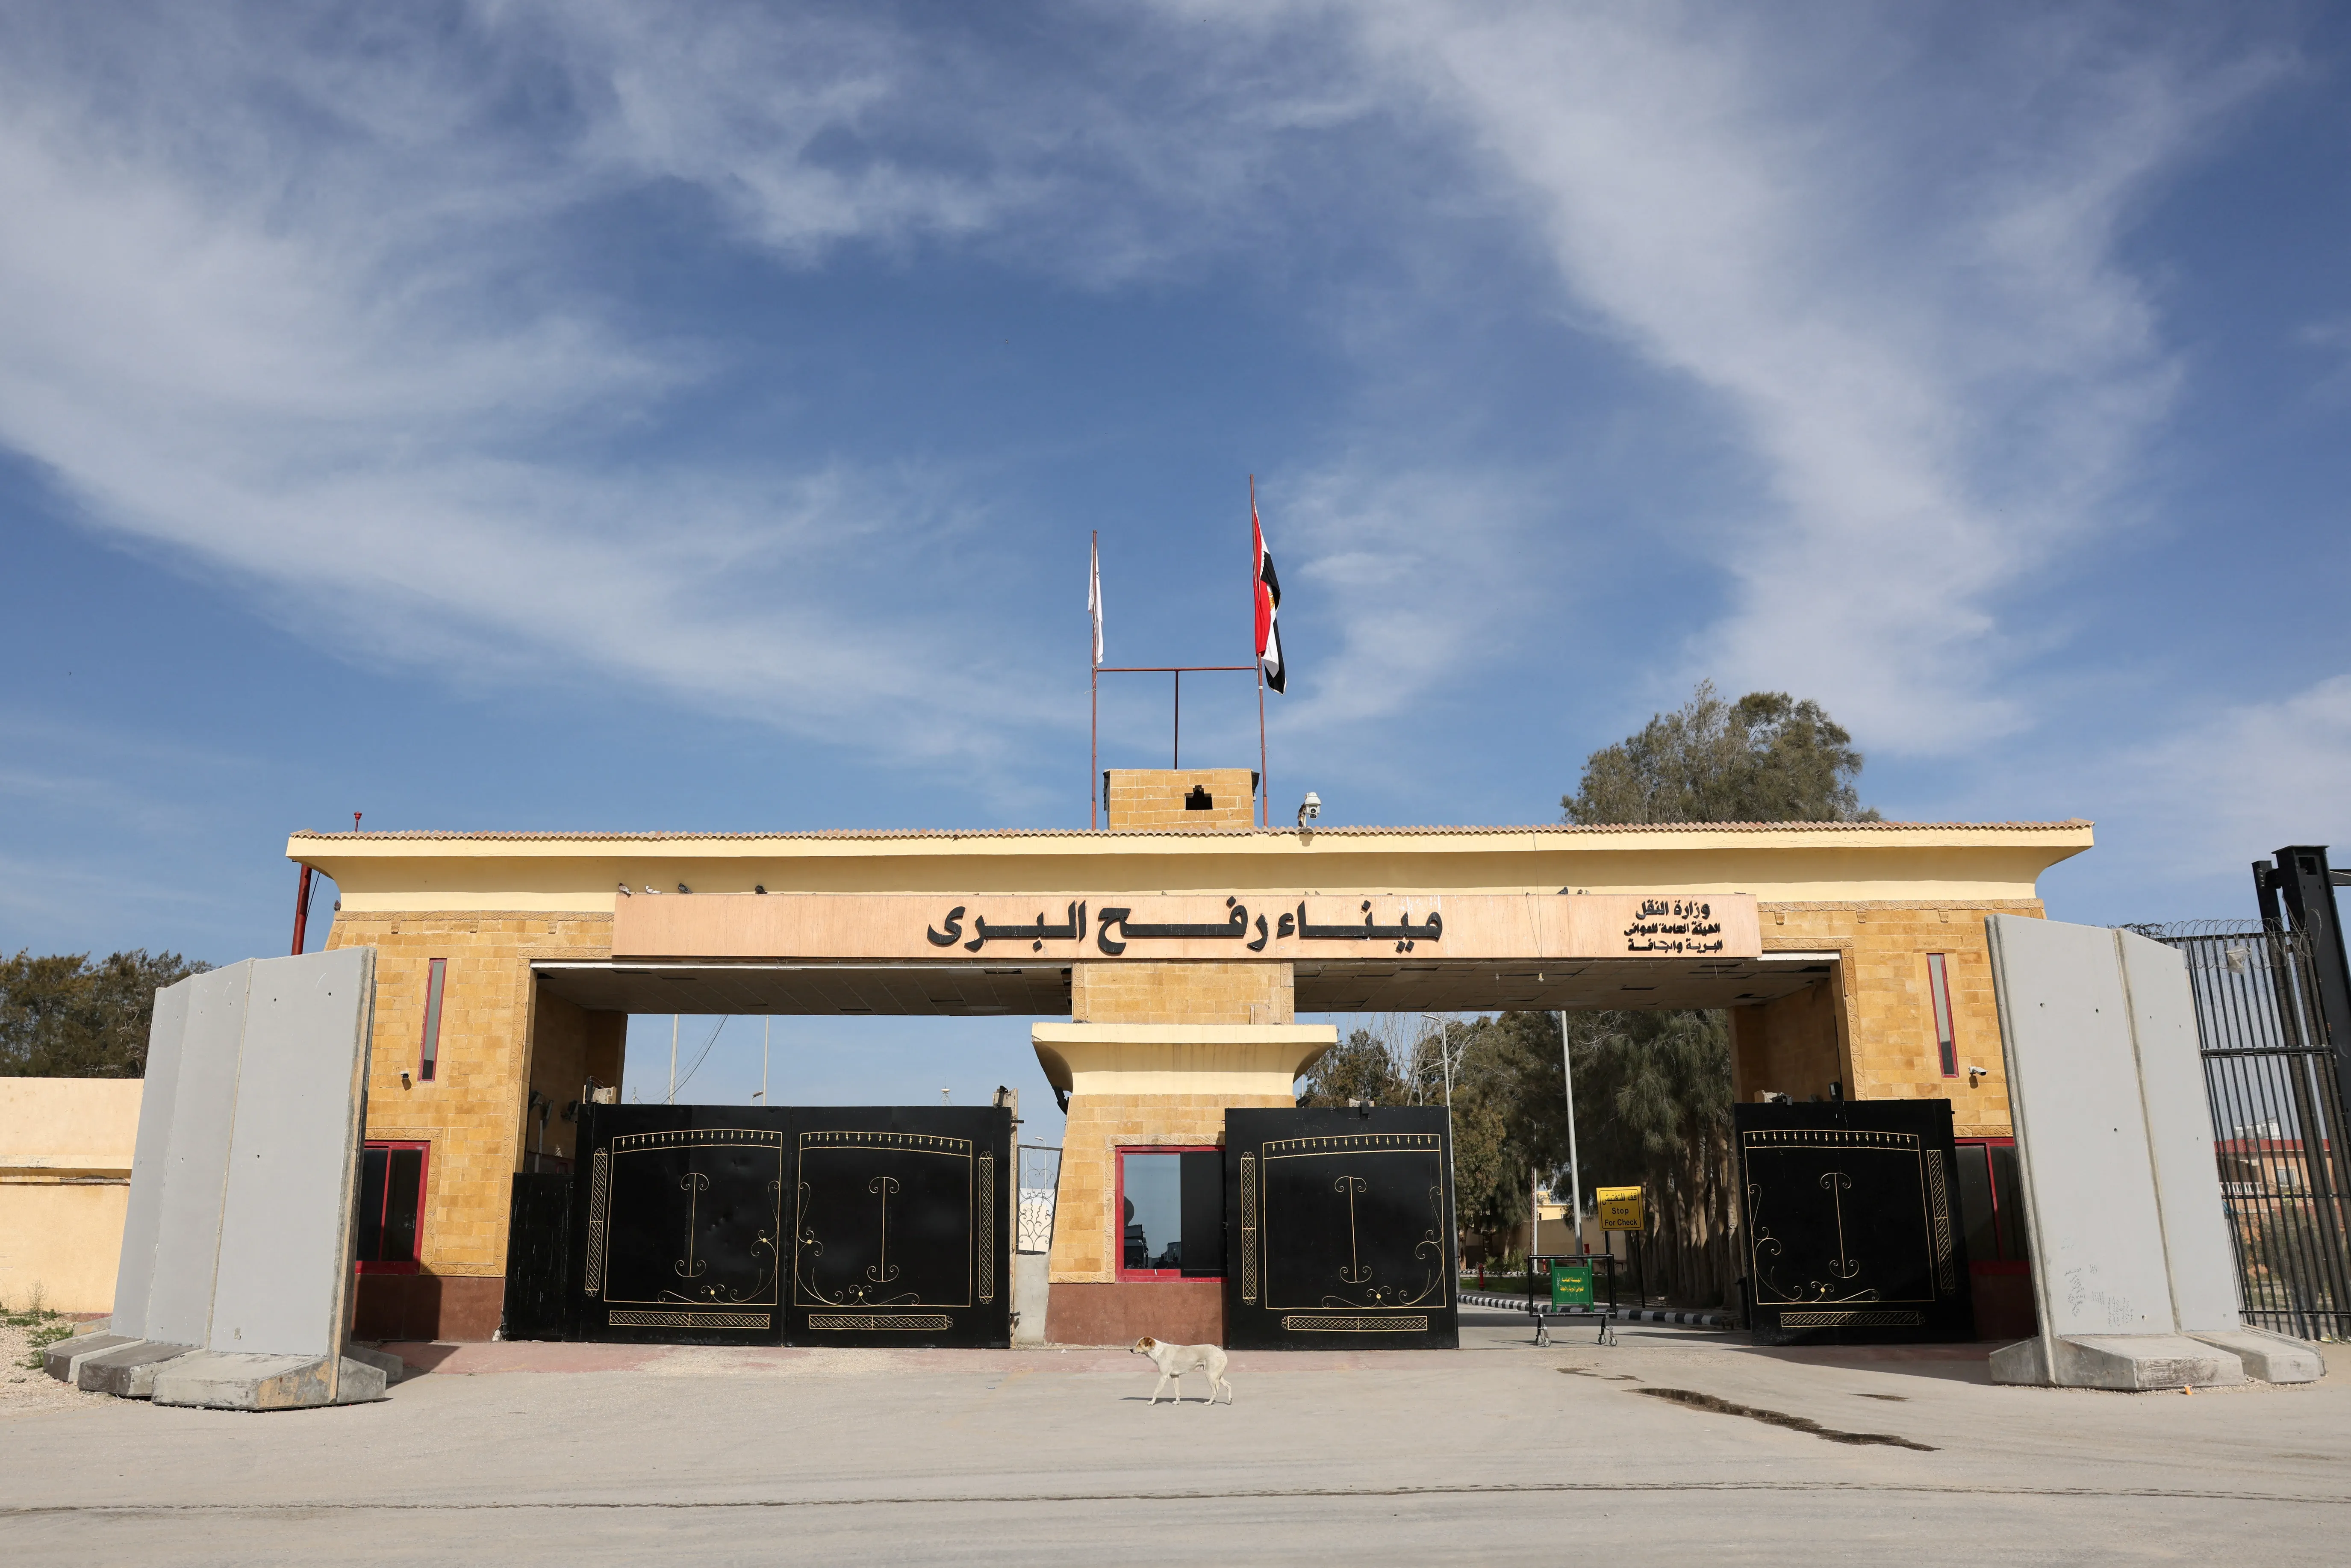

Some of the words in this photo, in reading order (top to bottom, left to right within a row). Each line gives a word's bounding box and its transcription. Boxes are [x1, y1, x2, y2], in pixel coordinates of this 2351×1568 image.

[1635, 899, 1669, 920] النقل
[1673, 899, 1711, 920] وزارة
[1097, 896, 1268, 954] رفح
[1276, 899, 1444, 954] ميناء
[1659, 923, 1690, 934] العامة
[1686, 938, 1723, 954] البرية
[1602, 1193, 1625, 1205] للتفتيش
[1628, 1192, 1637, 1200] قف
